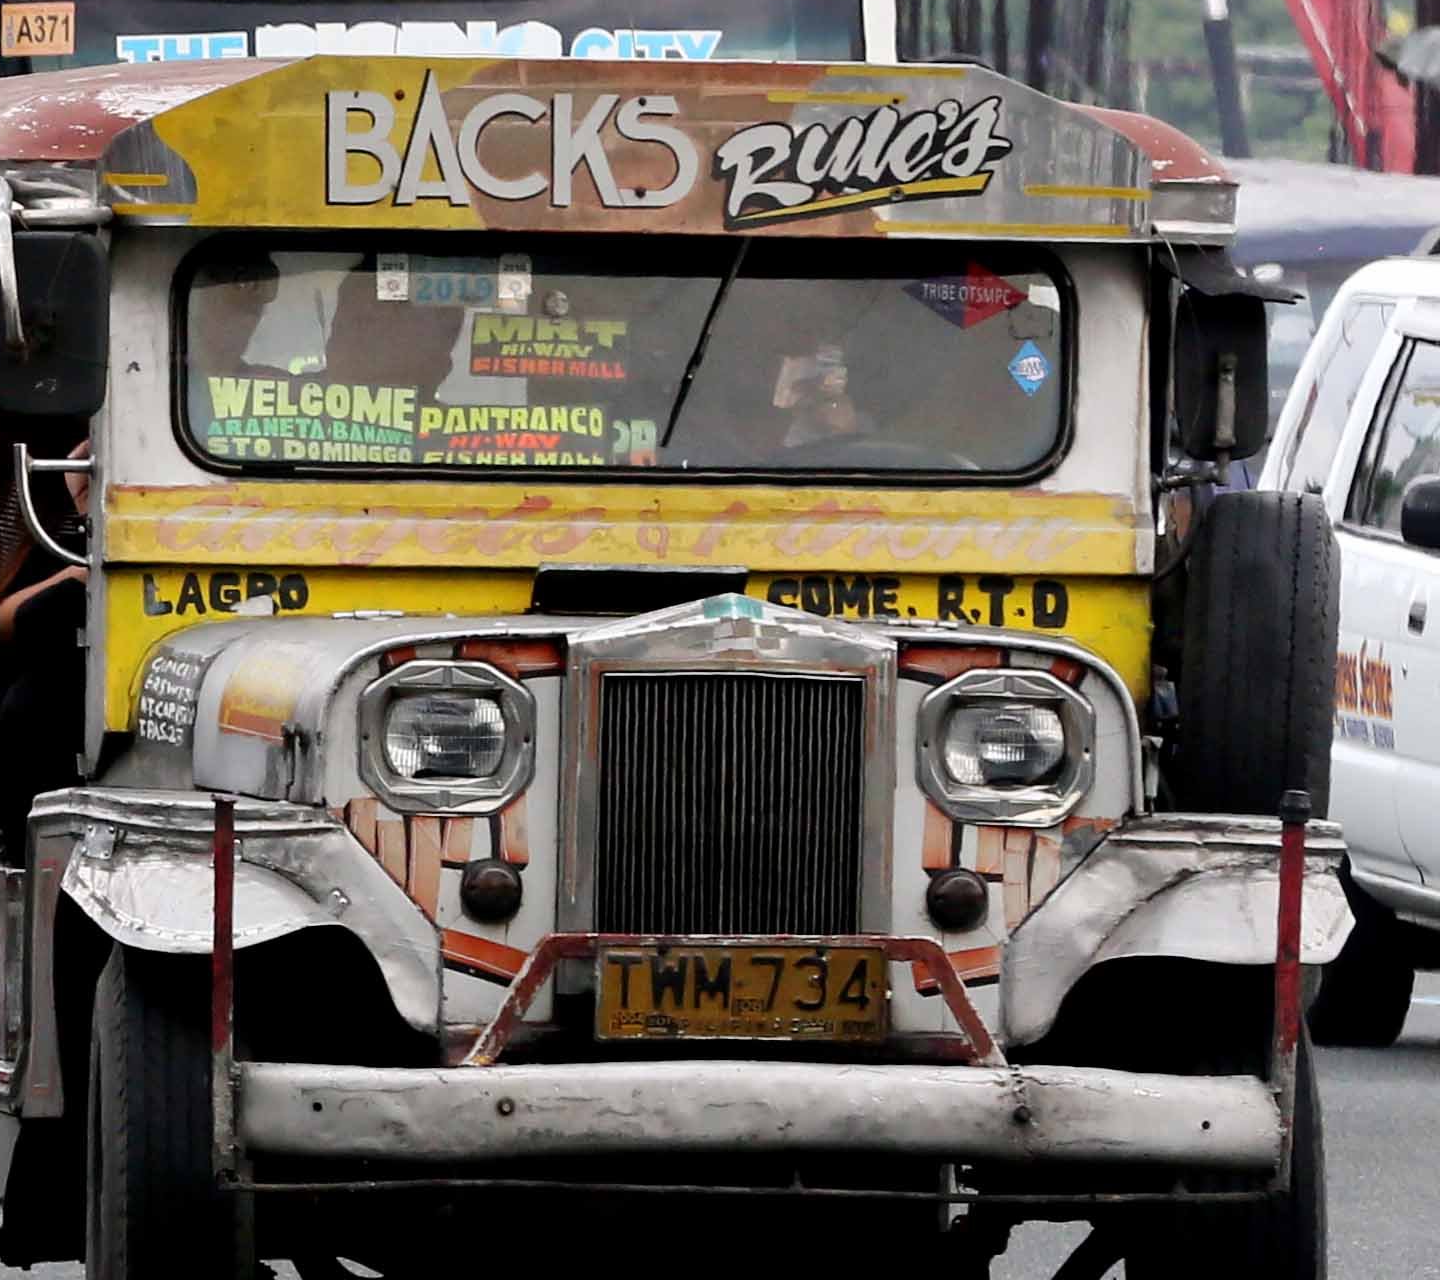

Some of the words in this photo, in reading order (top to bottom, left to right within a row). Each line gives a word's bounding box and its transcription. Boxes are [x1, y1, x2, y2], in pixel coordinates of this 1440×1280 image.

[17, 15, 70, 43] A371
[325, 69, 698, 209] BACKS
[417, 274, 495, 302] 2019
[923, 283, 956, 301] TRIBE
[473, 314, 628, 348] MRT
[208, 377, 416, 433] WELCOME
[420, 407, 603, 438] PANTRANCO
[208, 437, 277, 459] STO.
[142, 572, 309, 617] LAGRO
[607, 955, 732, 1011] TWM
[751, 955, 871, 1012] 734
